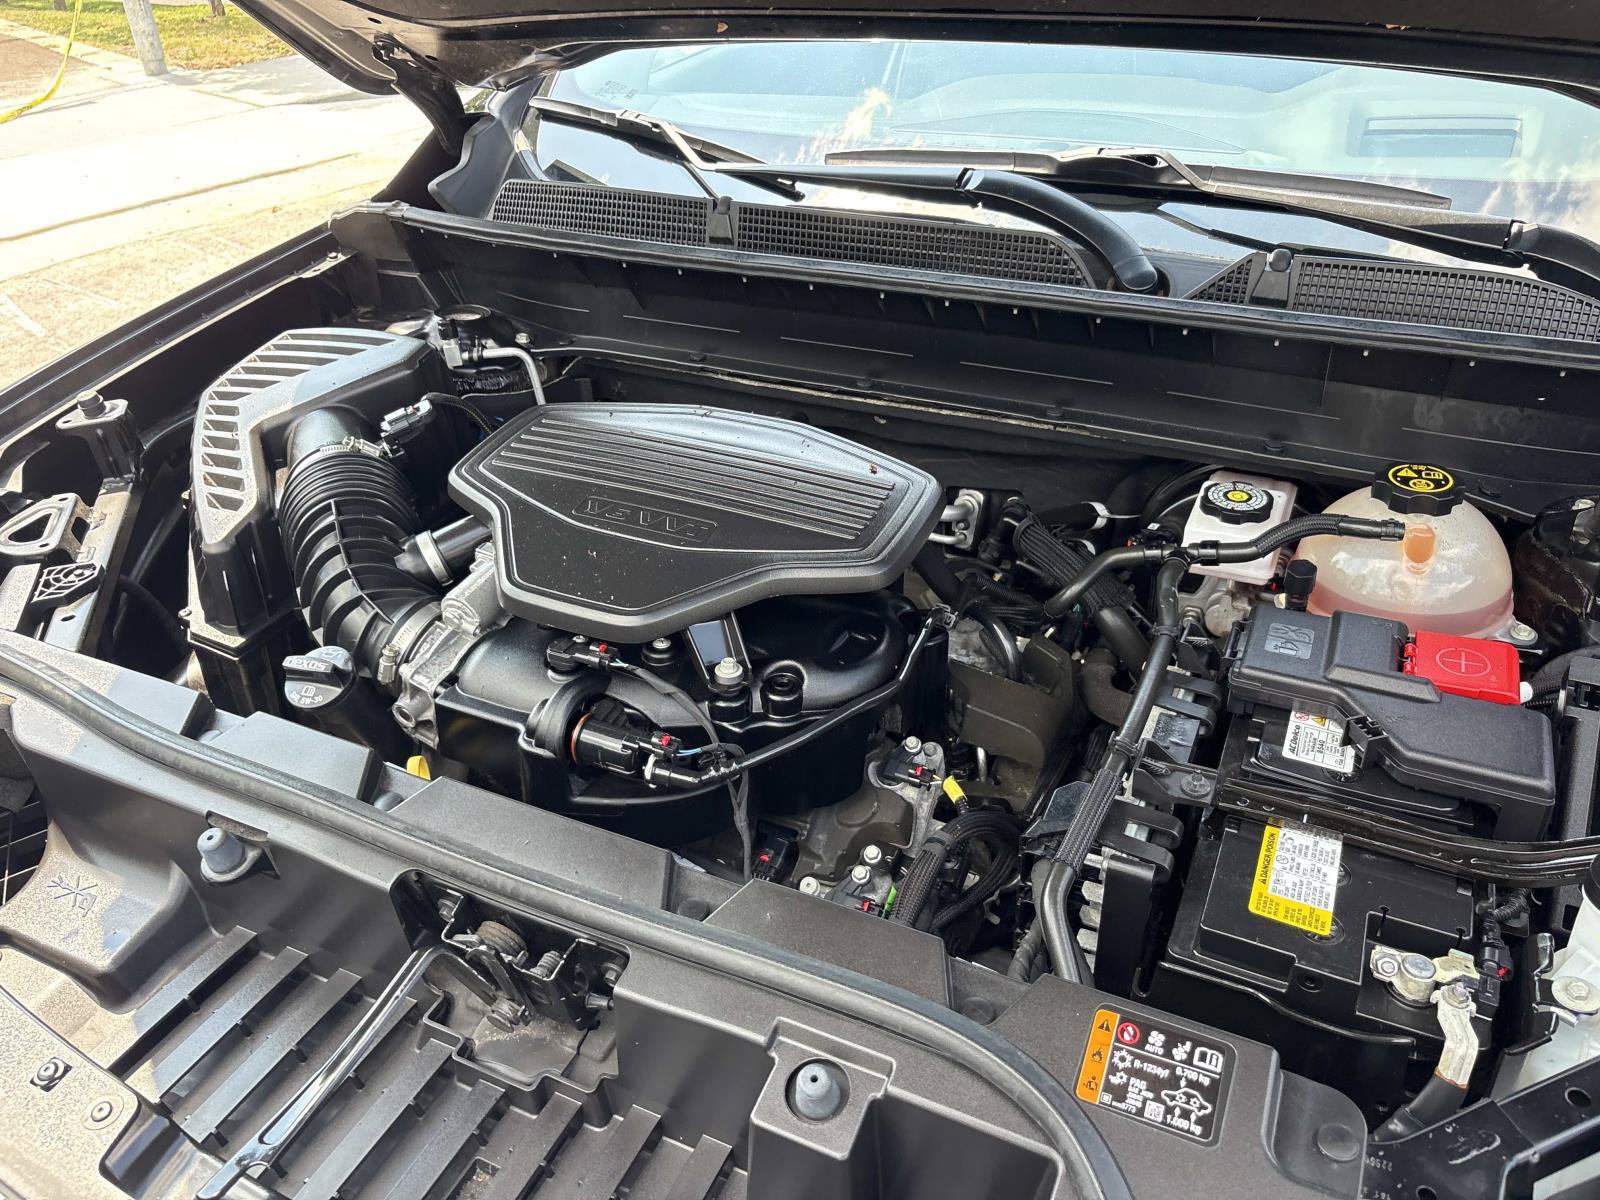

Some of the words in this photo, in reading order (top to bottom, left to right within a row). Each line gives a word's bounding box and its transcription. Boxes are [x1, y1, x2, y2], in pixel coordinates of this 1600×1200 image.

[284, 656, 329, 671] dexos
[300, 694, 323, 705] 5W-30
[1288, 724, 1301, 755] ACDelco
[1144, 1043, 1164, 1056] AUTO
